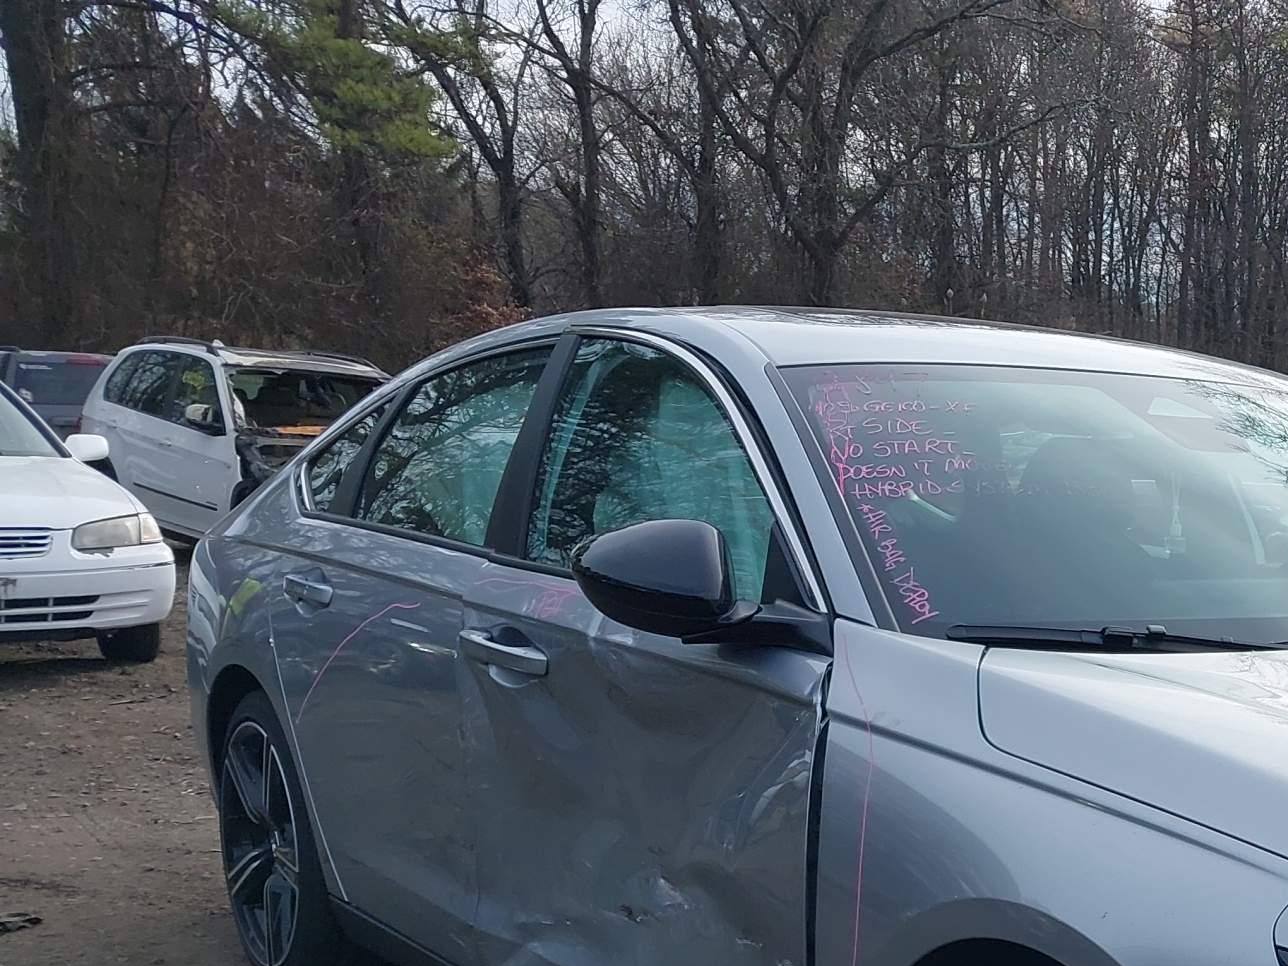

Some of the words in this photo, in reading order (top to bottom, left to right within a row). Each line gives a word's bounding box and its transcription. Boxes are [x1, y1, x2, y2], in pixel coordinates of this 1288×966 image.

[862, 417, 934, 436] SIDE
[831, 437, 864, 462] NO
[873, 440, 960, 459] START
[849, 479, 943, 500] HYBRID
